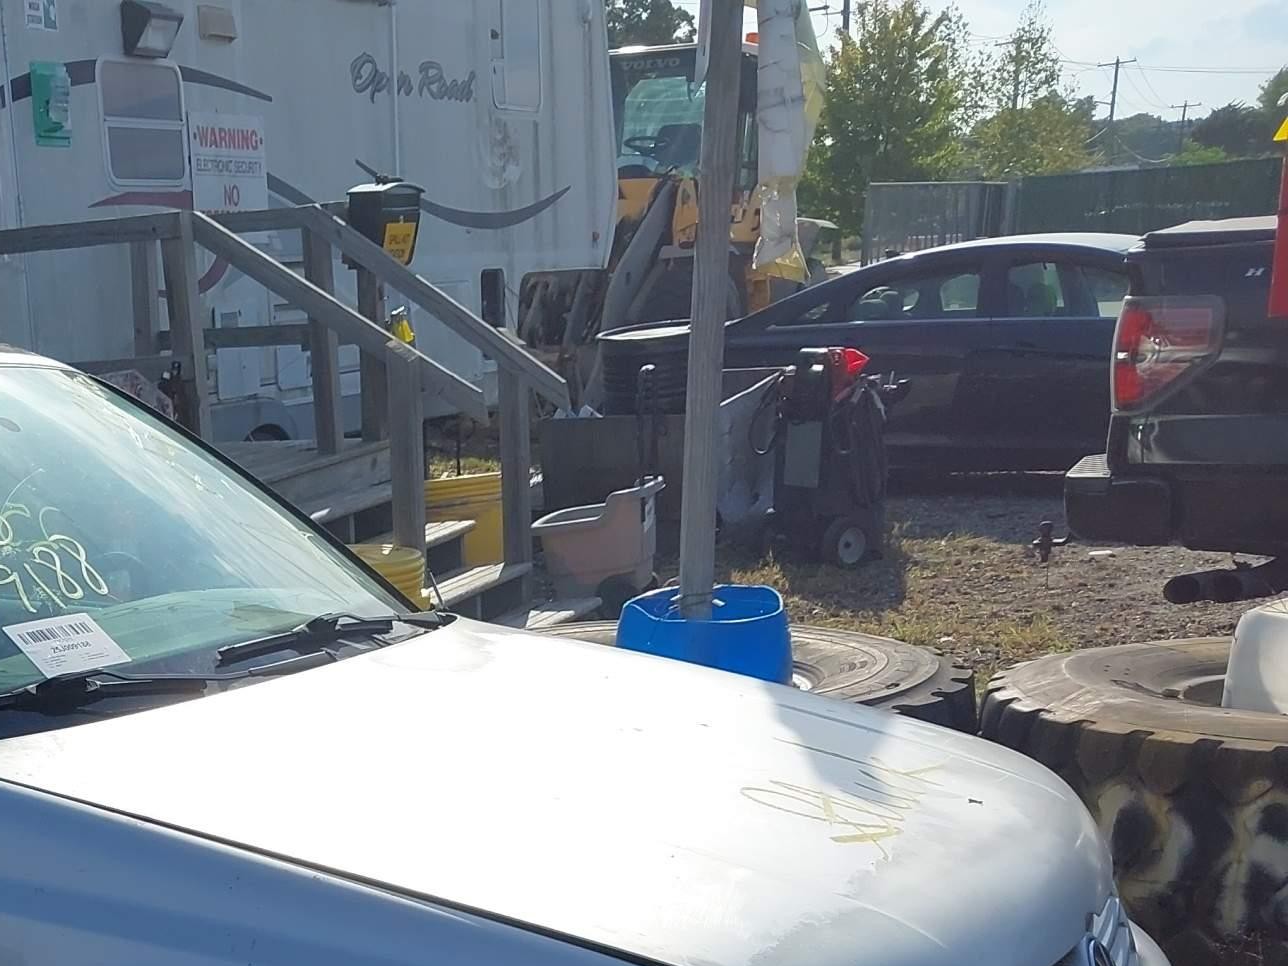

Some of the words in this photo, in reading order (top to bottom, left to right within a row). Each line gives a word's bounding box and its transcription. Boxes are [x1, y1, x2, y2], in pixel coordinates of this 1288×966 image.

[620, 58, 681, 70] VOLVO
[350, 51, 413, 104] Opn
[418, 60, 476, 103] Road
[196, 126, 259, 151] WARNING
[196, 158, 233, 173] ELECTRONIC
[234, 160, 262, 174] SECURITY
[223, 183, 240, 207] NO
